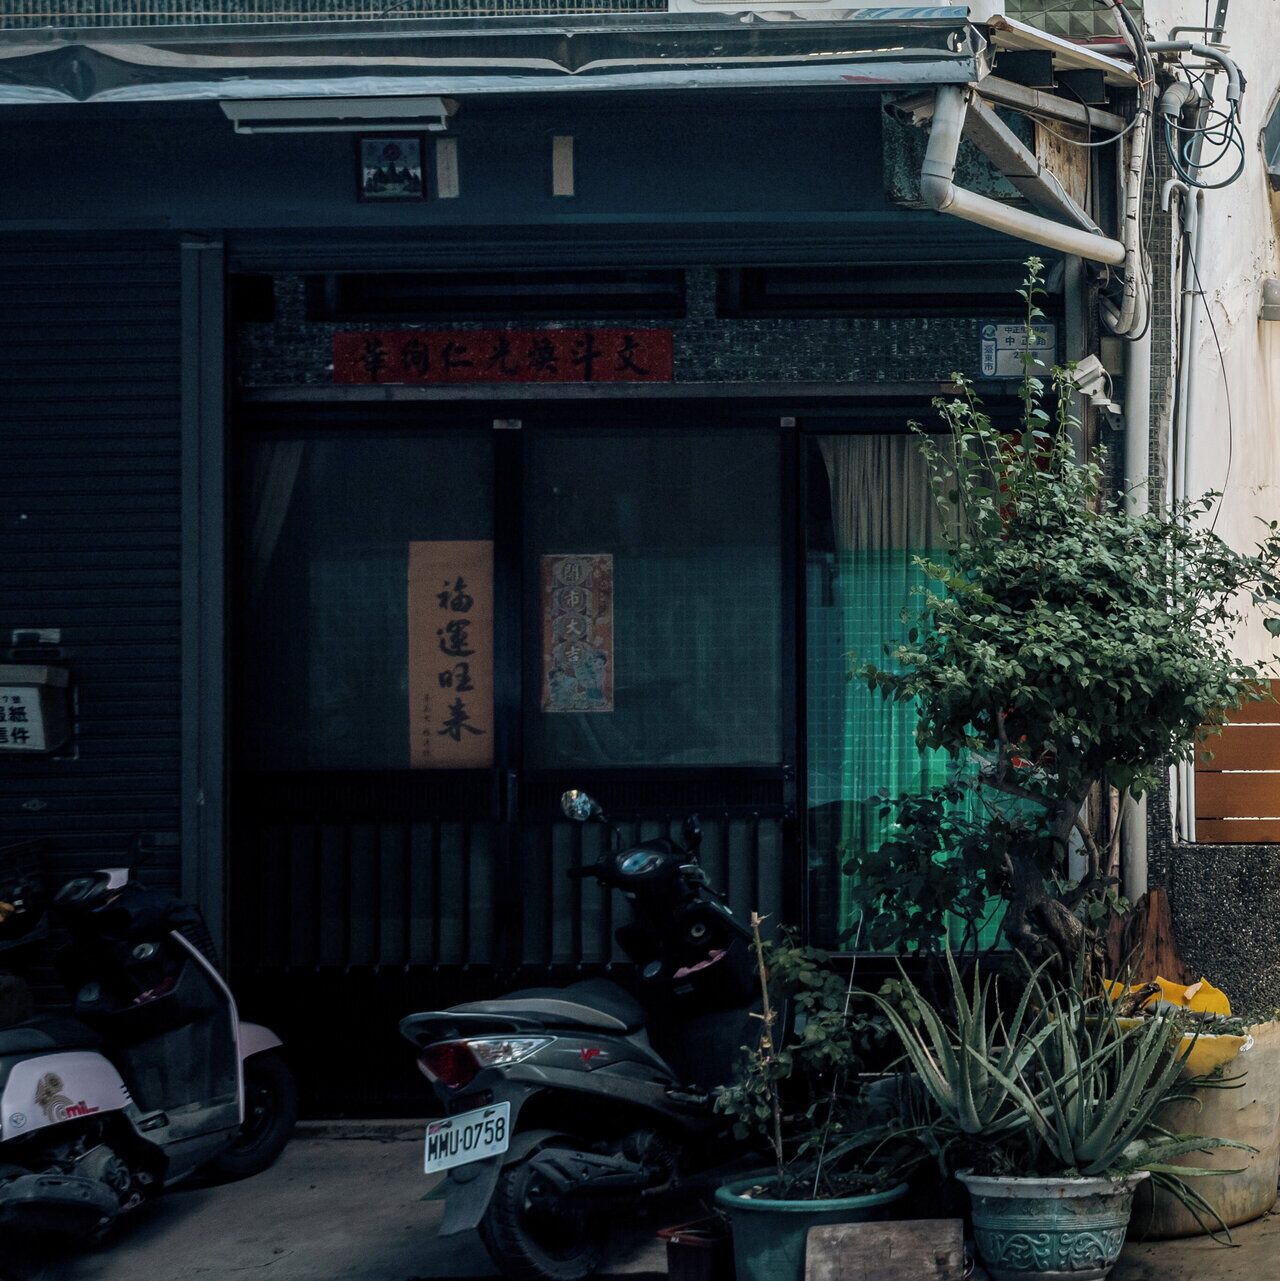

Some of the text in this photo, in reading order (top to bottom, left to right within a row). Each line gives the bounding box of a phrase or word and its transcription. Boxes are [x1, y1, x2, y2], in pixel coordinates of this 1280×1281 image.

[564, 562, 583, 663] 開市大吉
[427, 1116, 506, 1162] MMU-0758
